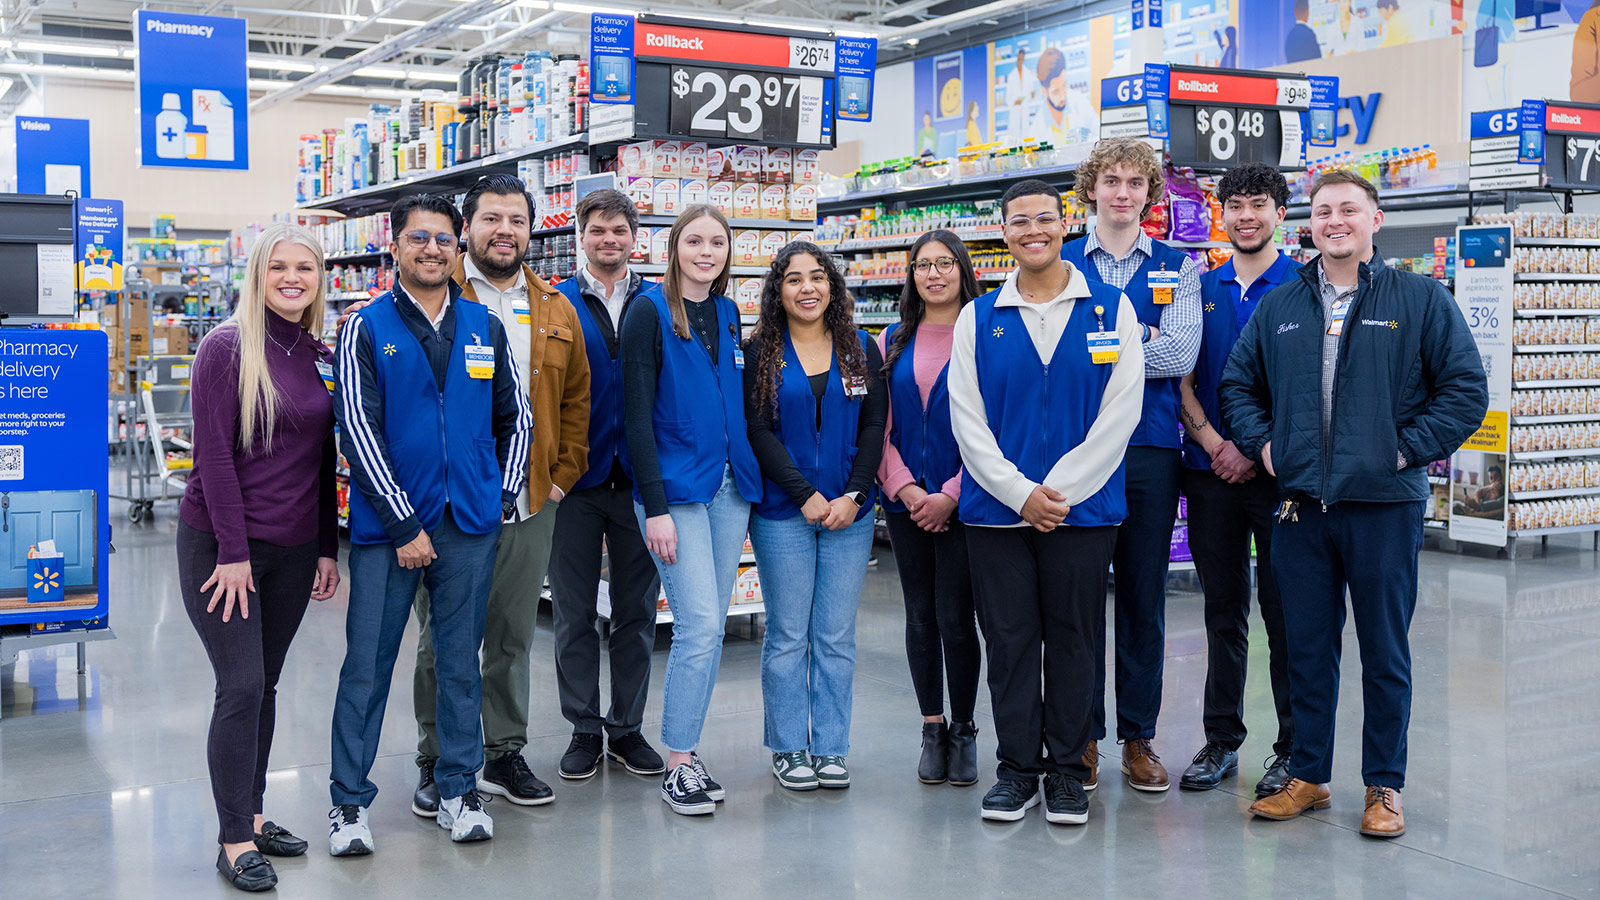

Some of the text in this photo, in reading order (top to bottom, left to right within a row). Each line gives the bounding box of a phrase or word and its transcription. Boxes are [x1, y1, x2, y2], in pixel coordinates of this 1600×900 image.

[594, 16, 628, 27] Pharmacy
[147, 20, 214, 38] Pharmacy
[594, 25, 622, 35] delivery
[601, 35, 617, 43] here
[646, 34, 704, 50] Rollback
[840, 39, 871, 50] Pharmacy
[839, 49, 864, 58] delivery
[1178, 80, 1218, 93] Rollback
[1552, 113, 1581, 124] Rollback
[20, 120, 50, 131] Vision
[1470, 307, 1499, 328] 3%
[10, 382, 48, 398] here
[8, 412, 30, 420] meds,
[31, 412, 66, 420] groceries
[20, 420, 38, 428] right
